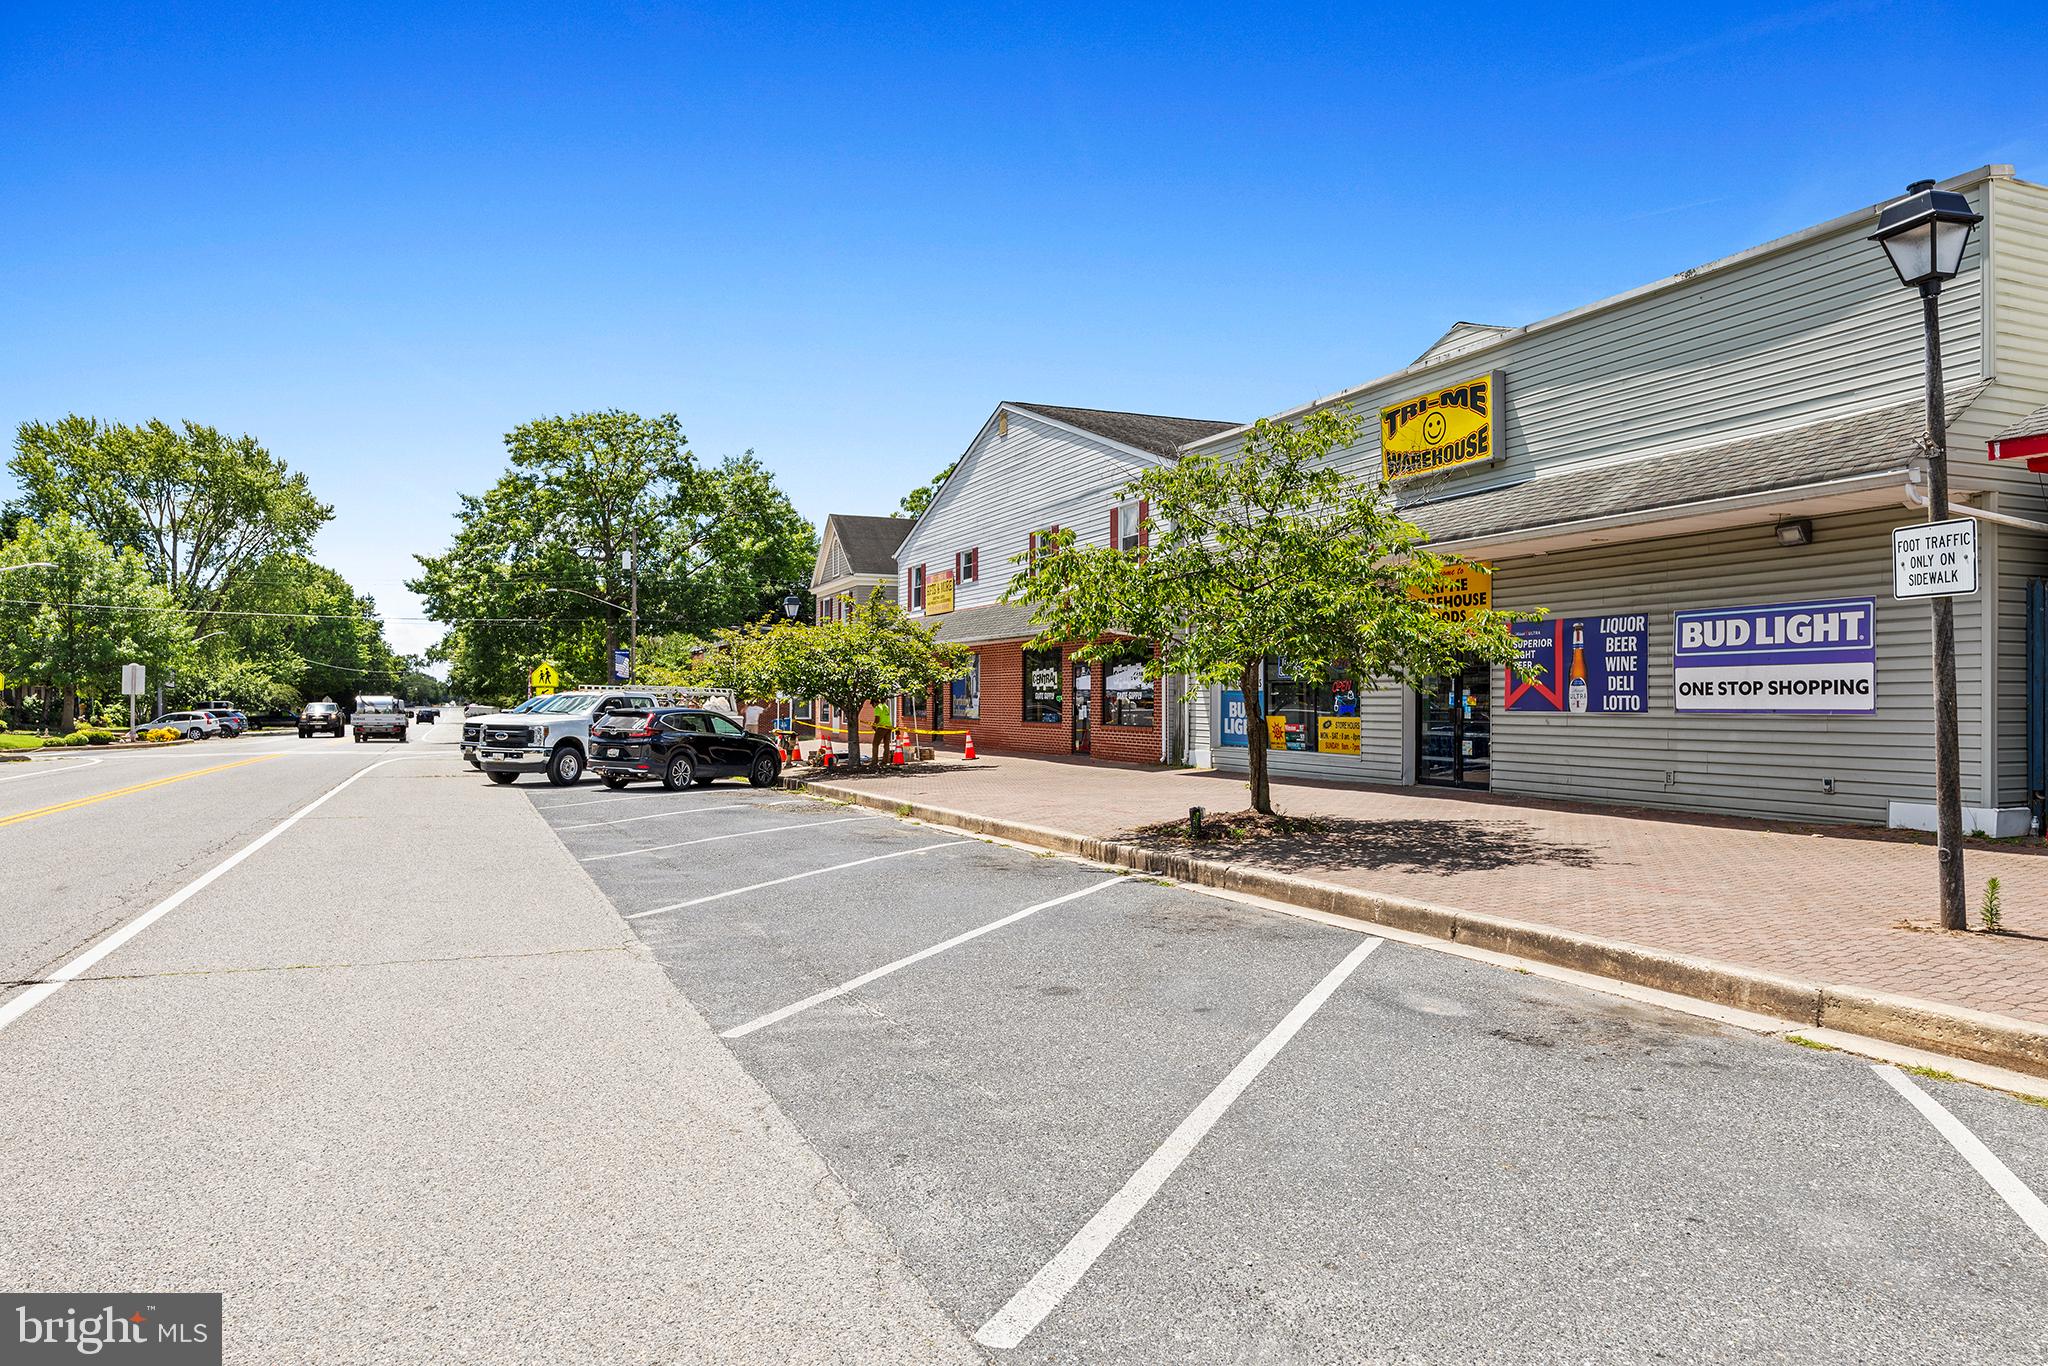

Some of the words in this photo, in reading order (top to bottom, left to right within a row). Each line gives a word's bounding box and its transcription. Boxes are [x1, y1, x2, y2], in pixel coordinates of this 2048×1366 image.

[1385, 383, 1488, 439] TRI-ME
[1386, 424, 1488, 476] WAREHOUSE
[1898, 539, 1920, 553] FOOT
[1925, 532, 1971, 549] TRAFFIC
[1911, 555, 1934, 569] ONLY
[1941, 552, 1956, 566] ON
[1909, 570, 1958, 586] SIDEWALK
[1600, 616, 1645, 634] LIQUOR
[1682, 619, 1750, 648] BUD
[1755, 611, 1865, 645] LIGHT
[1513, 638, 1552, 649] SUPERIOR
[1606, 637, 1637, 652] BEER
[1605, 656, 1637, 672] WINE
[1033, 671, 1057, 686] CENTRAL
[1332, 680, 1352, 692] OPEN
[1608, 676, 1634, 691] DELI
[1679, 682, 1713, 696] ONE
[1718, 681, 1763, 696] STOP
[1768, 679, 1869, 695] SHOPPING
[1229, 701, 1248, 718] BU
[1603, 695, 1640, 711] LOTTO
[1224, 717, 1248, 735] LIG
[1335, 721, 1347, 729] STORE
